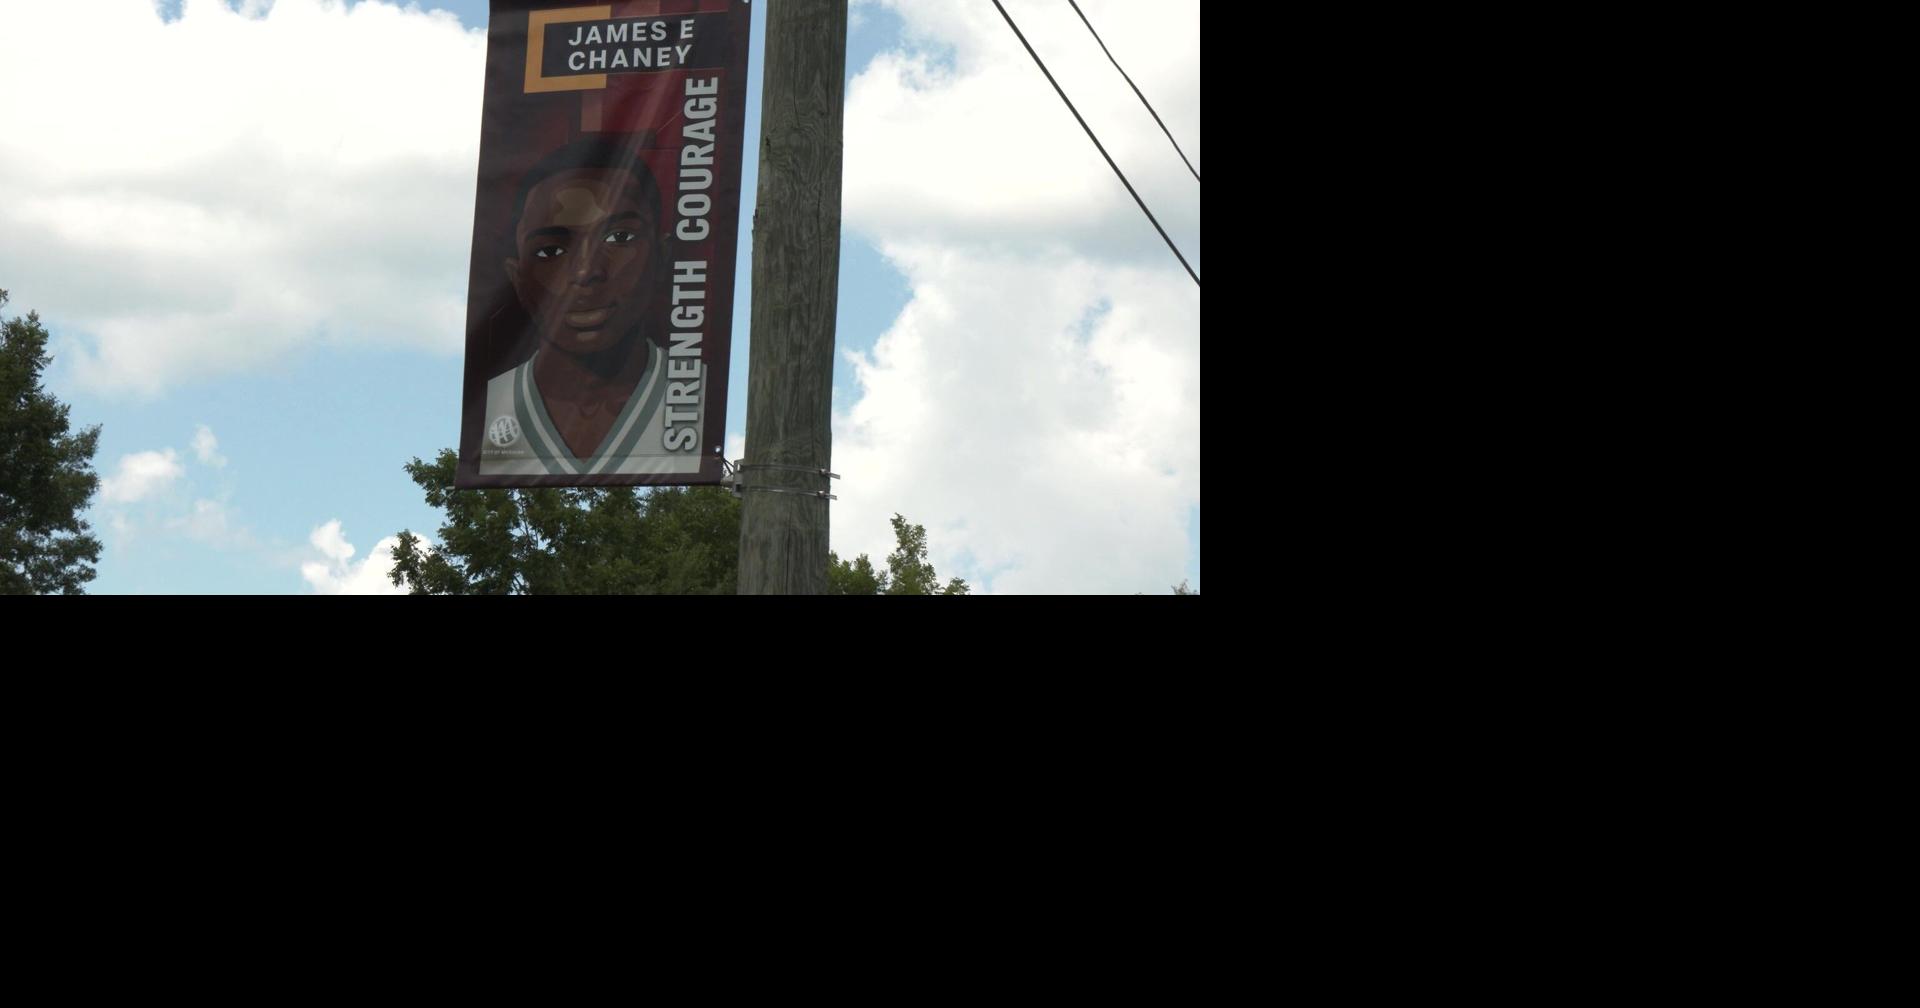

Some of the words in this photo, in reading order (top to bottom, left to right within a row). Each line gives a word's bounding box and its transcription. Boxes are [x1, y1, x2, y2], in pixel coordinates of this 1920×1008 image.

[568, 21, 667, 46] JAMES
[680, 19, 695, 39] E
[568, 44, 692, 71] CHANEY
[676, 77, 718, 241] COURAGE
[663, 260, 707, 451] STRENGTH
